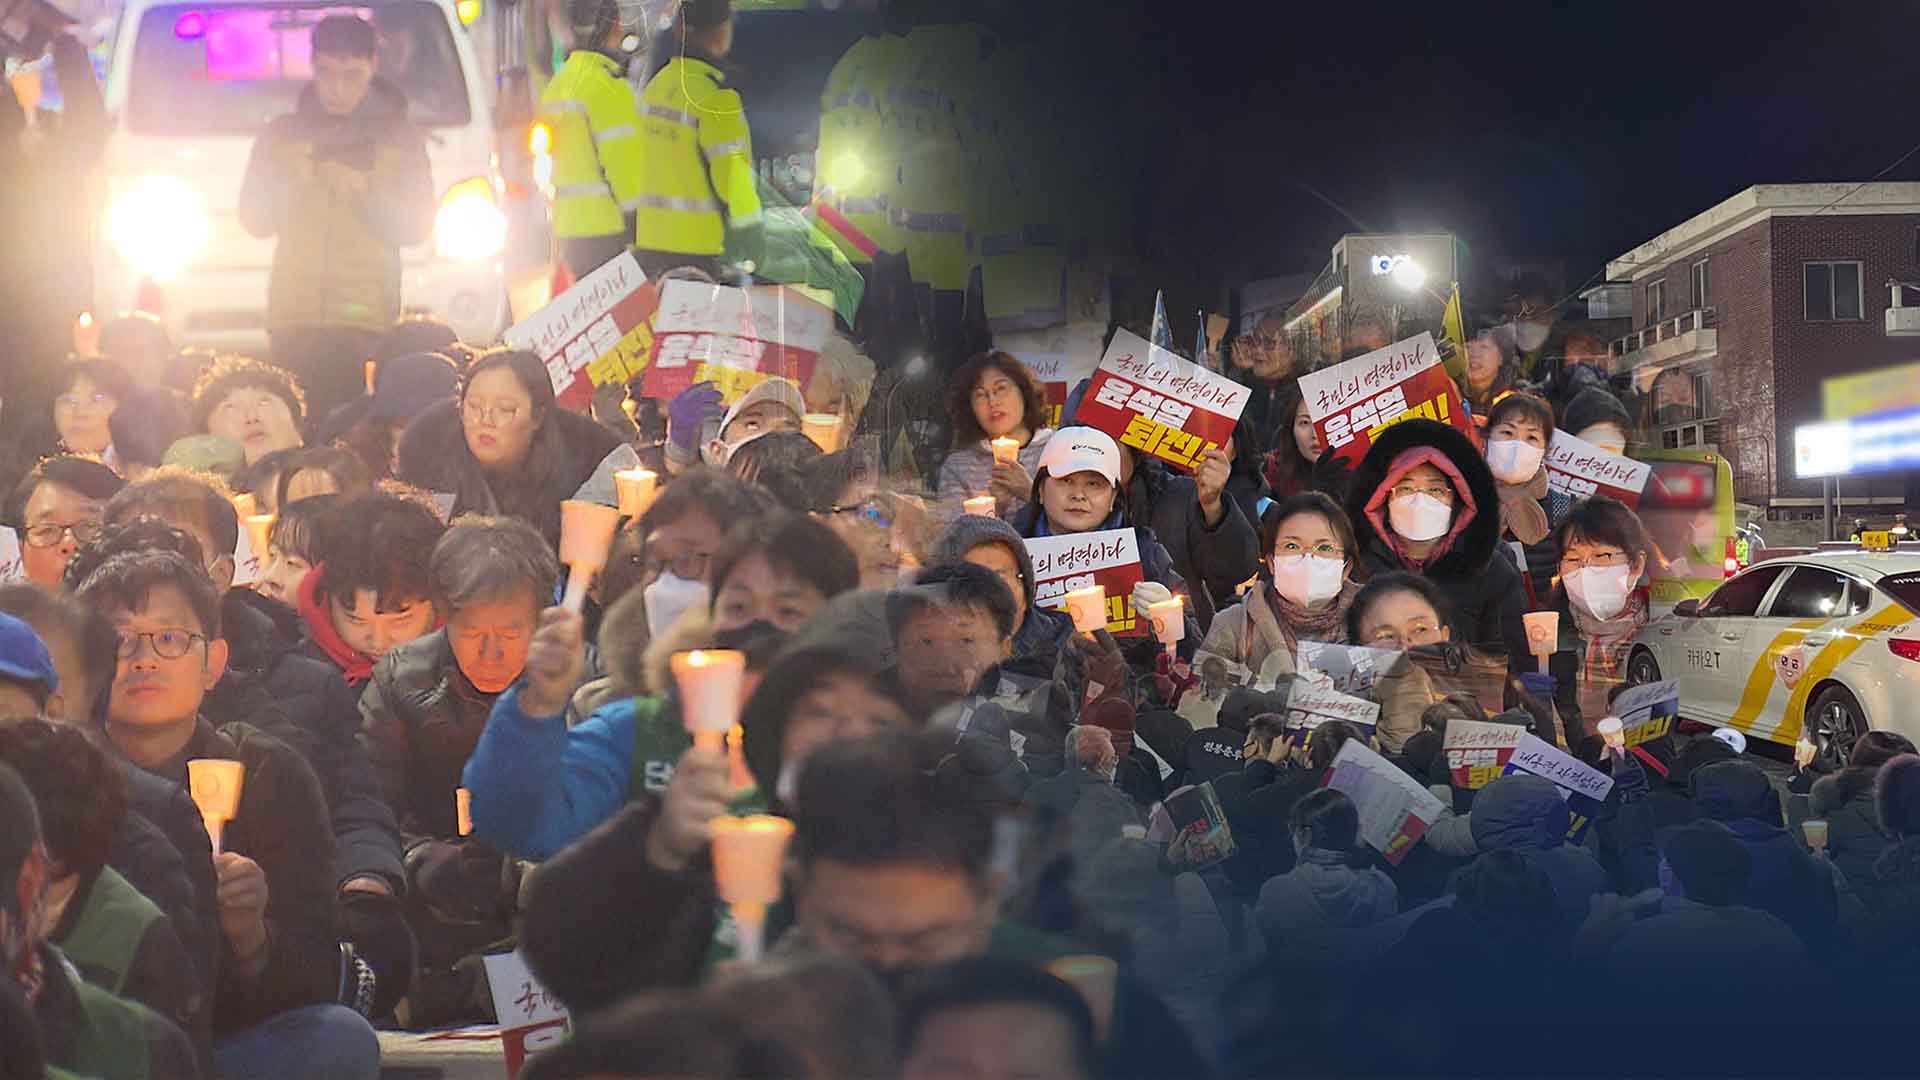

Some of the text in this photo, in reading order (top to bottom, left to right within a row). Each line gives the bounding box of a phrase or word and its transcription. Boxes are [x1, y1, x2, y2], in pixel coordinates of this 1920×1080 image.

[546, 313, 623, 396] 윤석열
[1116, 353, 1169, 386] 국민의
[1095, 377, 1194, 430] 윤석열
[1316, 375, 1360, 414] 국민의
[1324, 385, 1409, 449] 윤석열
